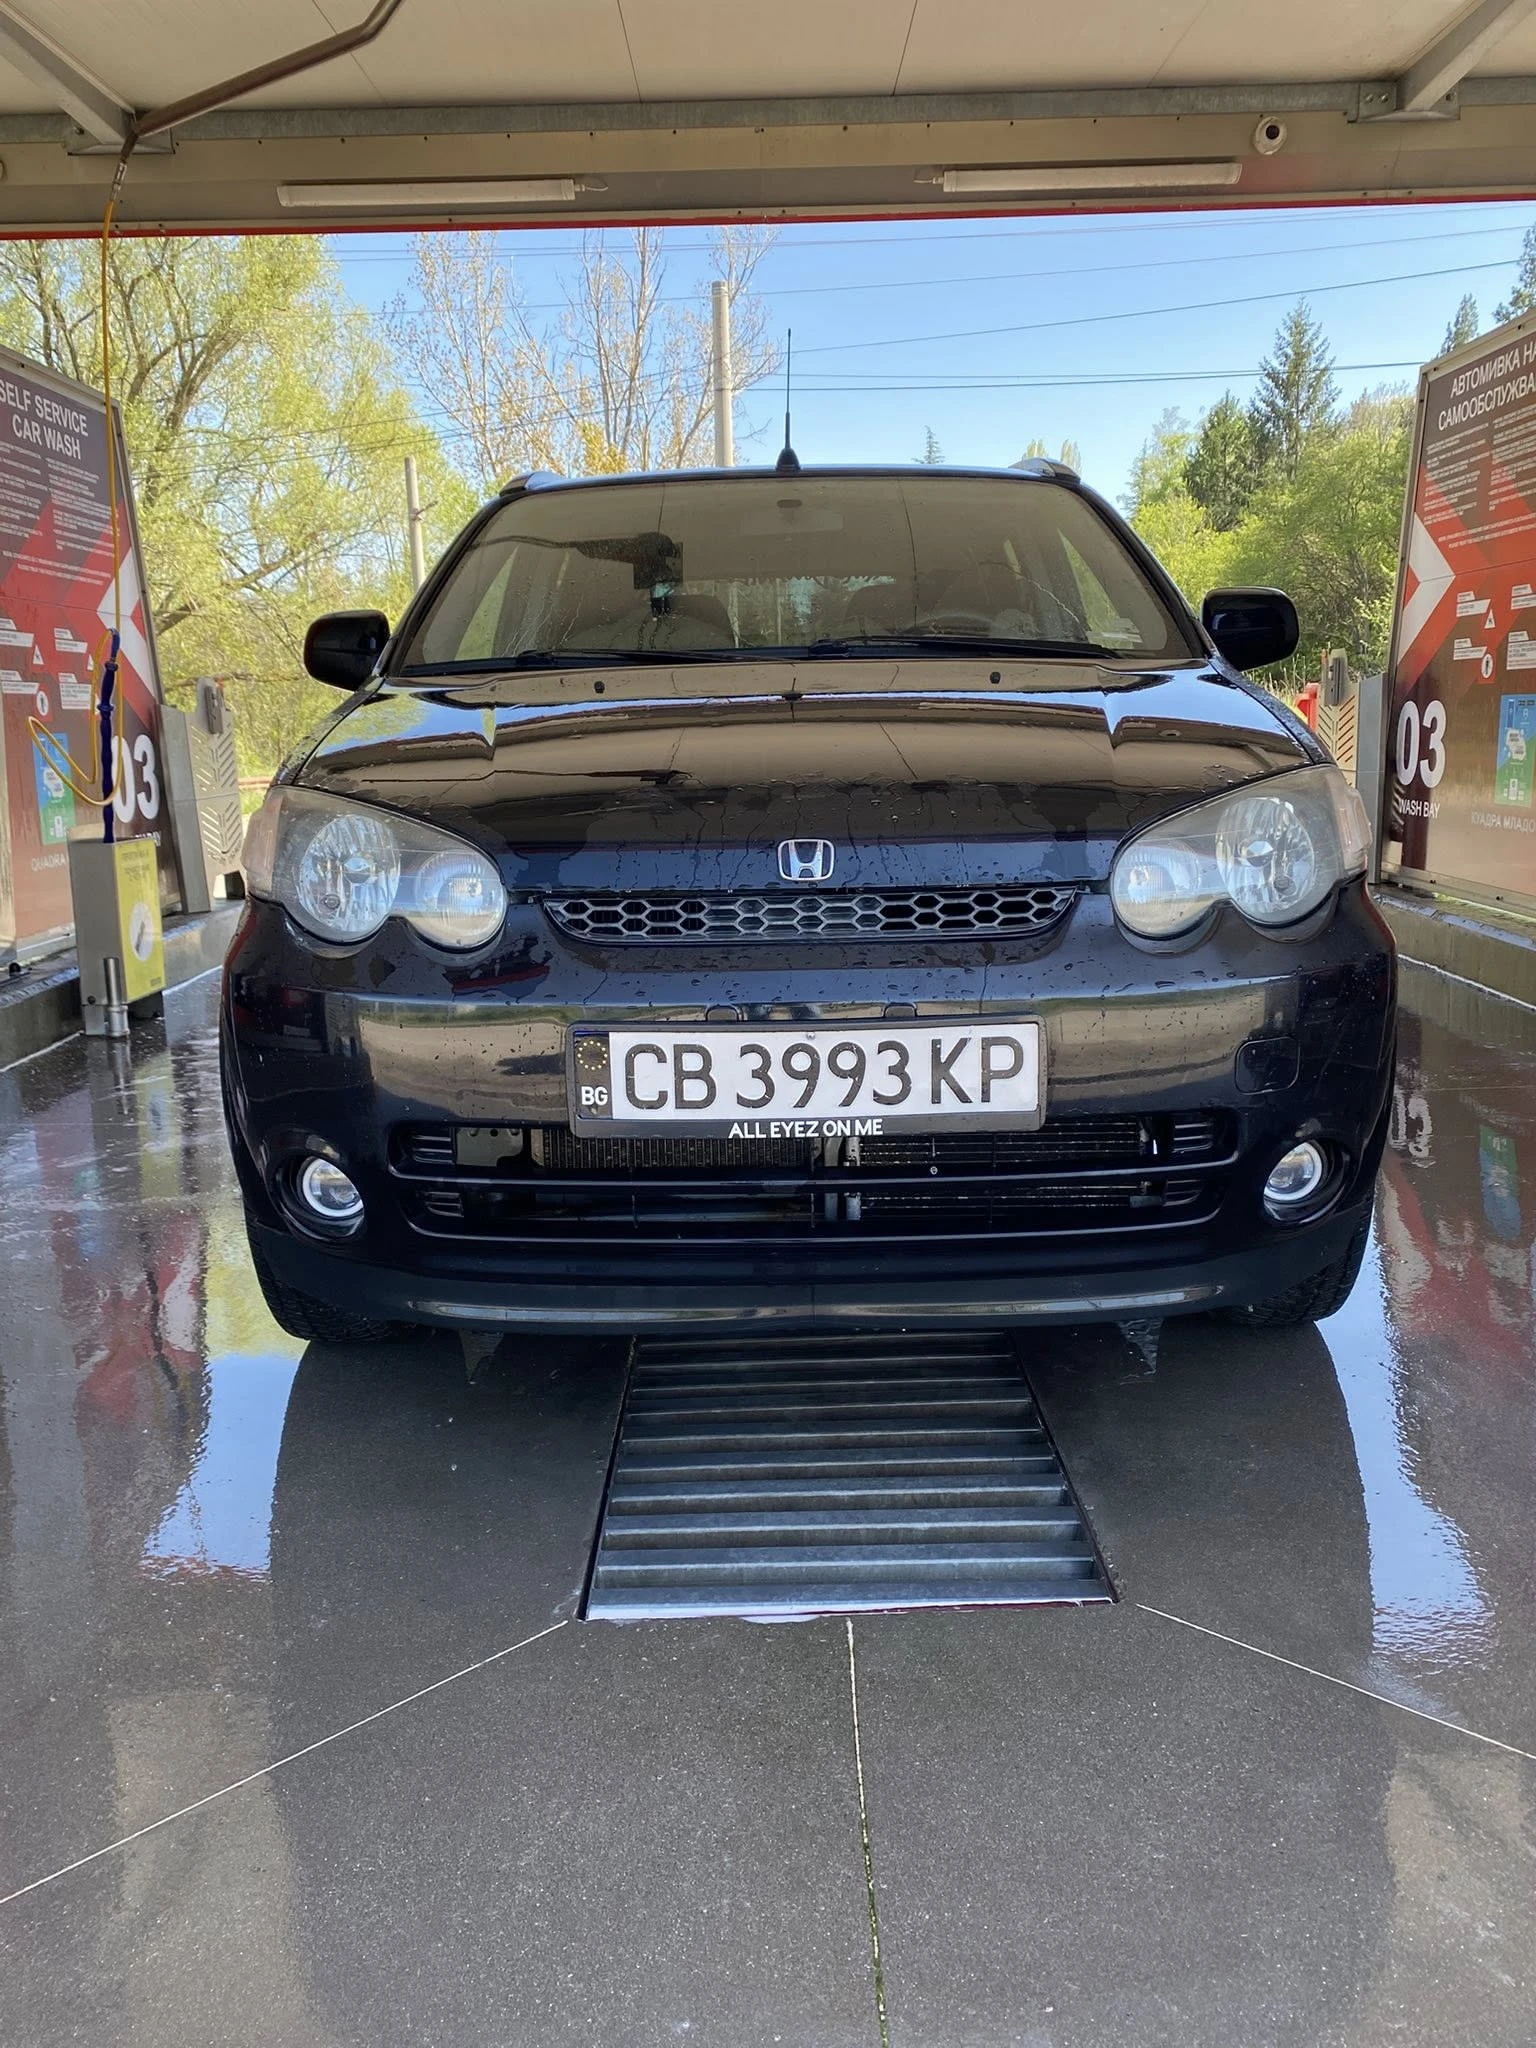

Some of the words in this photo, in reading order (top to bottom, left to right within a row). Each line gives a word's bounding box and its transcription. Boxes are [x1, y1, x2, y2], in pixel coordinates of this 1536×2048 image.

[1450, 348, 1520, 399] АВТОМИВКА
[0, 380, 31, 412] SELF
[34, 394, 89, 437] SERVICE
[1438, 372, 1536, 431] САМООБСЛУЖВА
[12, 413, 42, 446] CAR
[43, 425, 81, 460] WASH
[1397, 700, 1446, 789] 03
[111, 734, 160, 823] 03
[1399, 799, 1422, 817] WASH
[1423, 801, 1441, 819] BAY
[581, 1086, 608, 1106] BG
[736, 1041, 912, 1109] 3993
[728, 1122, 767, 1139] ALL
[770, 1121, 819, 1138] EYEZ
[822, 1120, 850, 1137] ON
[855, 1118, 884, 1136] ME
